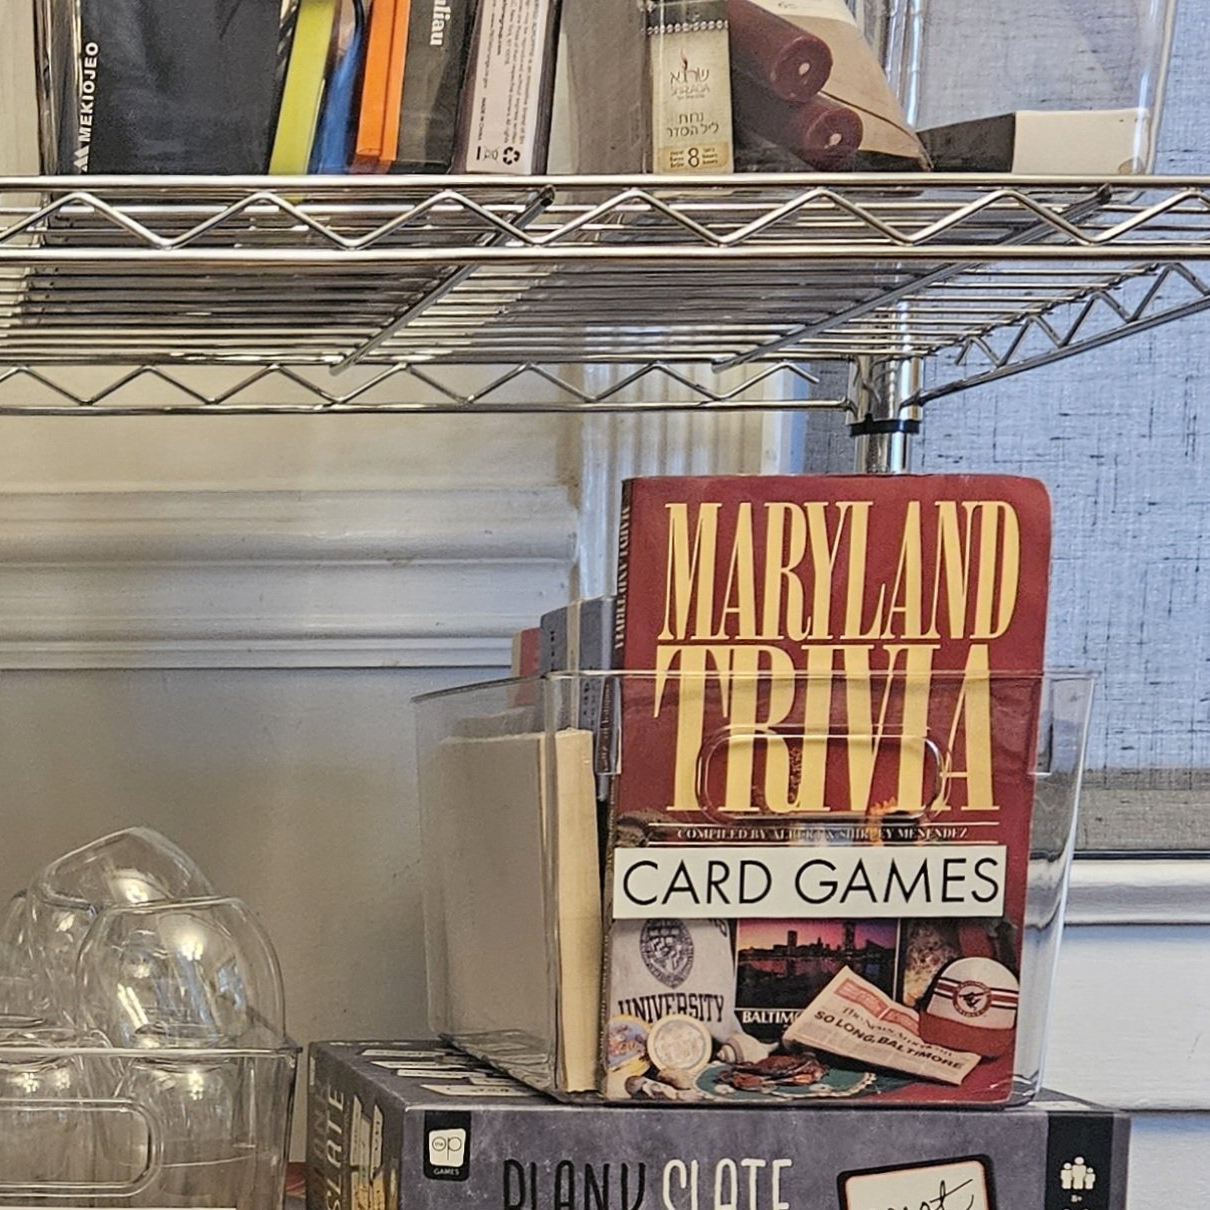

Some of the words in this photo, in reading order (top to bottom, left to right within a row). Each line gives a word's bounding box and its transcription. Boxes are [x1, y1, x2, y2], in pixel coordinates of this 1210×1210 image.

[78, 42, 98, 143] MEKIOJEO
[688, 147, 699, 168] 8
[658, 500, 1021, 641] MARYLAND
[653, 643, 1000, 813] TRIVIA
[677, 827, 749, 840] COMPILED
[750, 827, 766, 839] BY
[623, 857, 772, 905] CARD
[793, 856, 1000, 904] GAMES
[618, 992, 724, 1023] UNIVERSITY
[814, 1010, 835, 1023] SO
[878, 1036, 966, 1070] BALTIMORE
